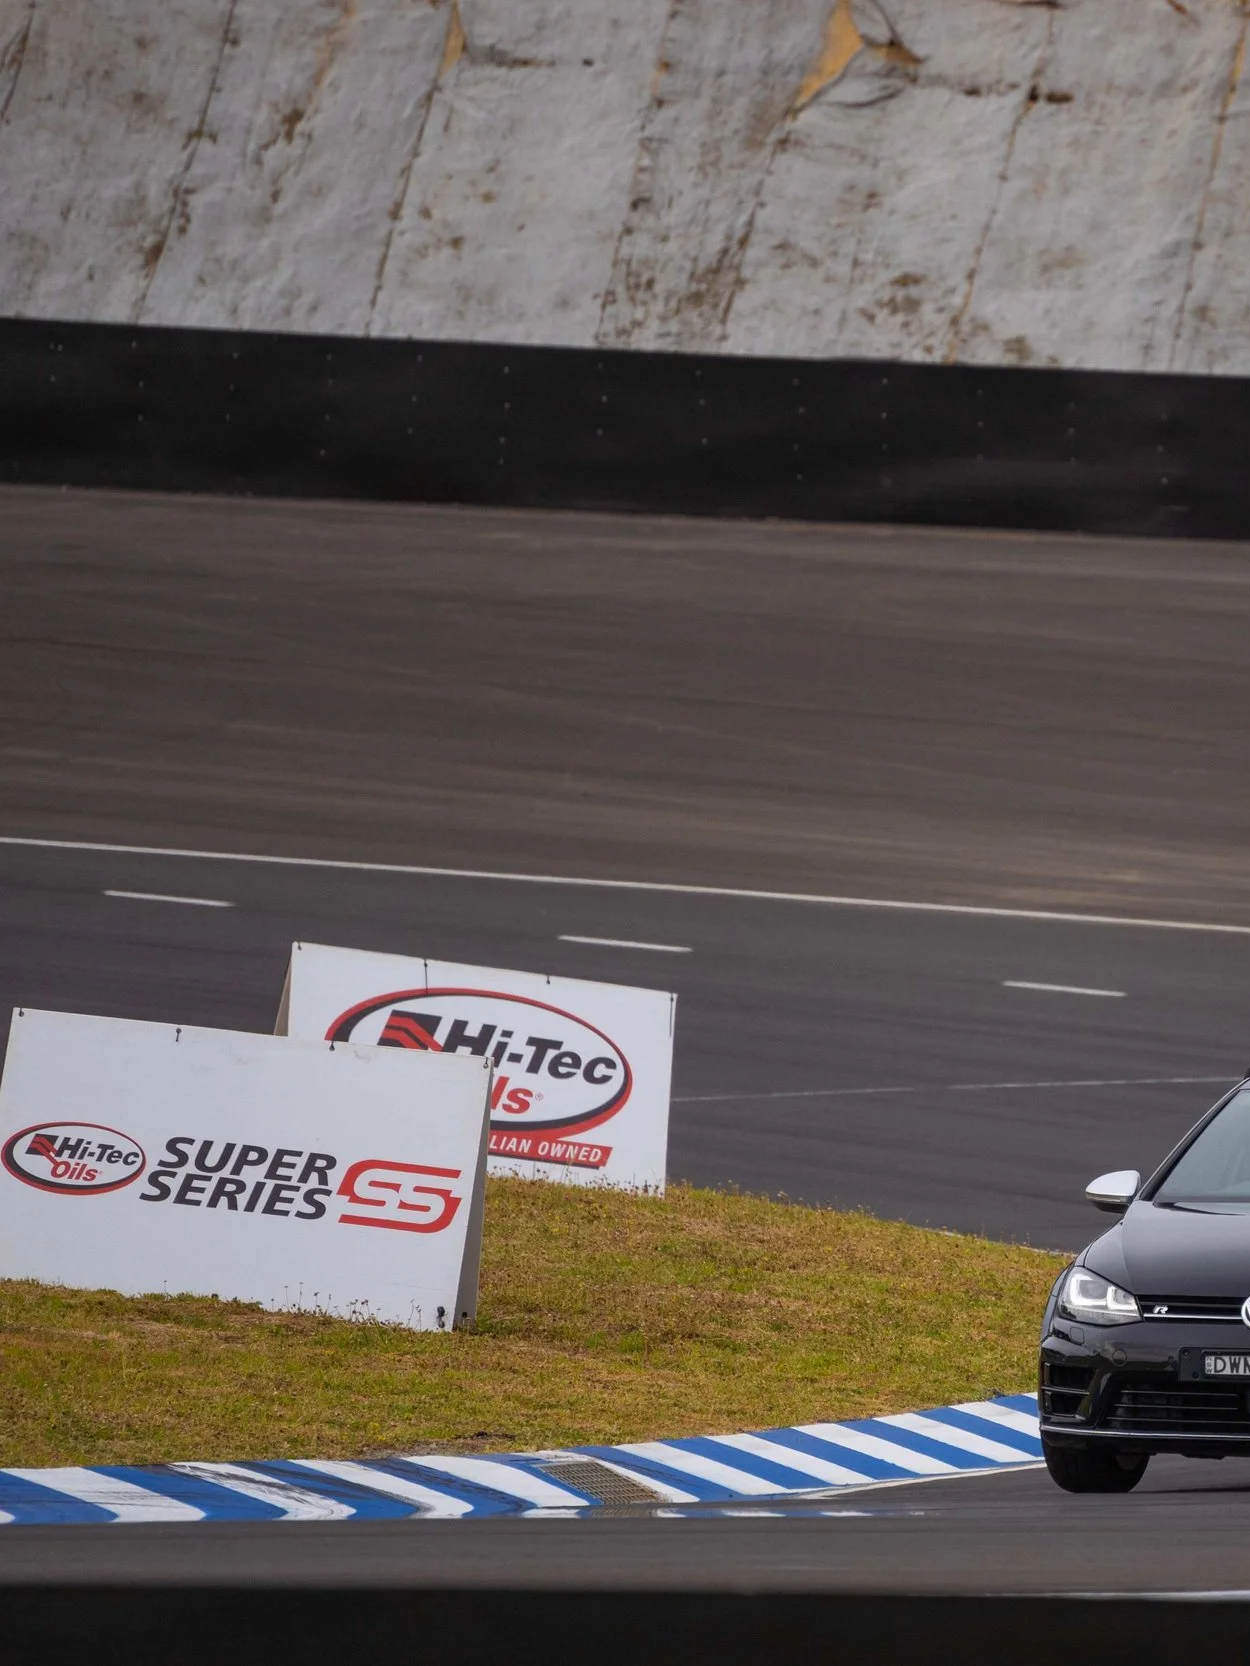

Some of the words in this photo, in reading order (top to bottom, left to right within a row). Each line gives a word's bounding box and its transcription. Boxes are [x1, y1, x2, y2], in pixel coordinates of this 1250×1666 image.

[443, 1018, 617, 1085] Hi-Tec
[51, 1160, 98, 1182] Oils
[54, 1136, 140, 1166] Hi-Tec
[157, 1136, 337, 1187] SUPER
[538, 1141, 602, 1163] OWNED
[139, 1169, 333, 1220] SERIES
